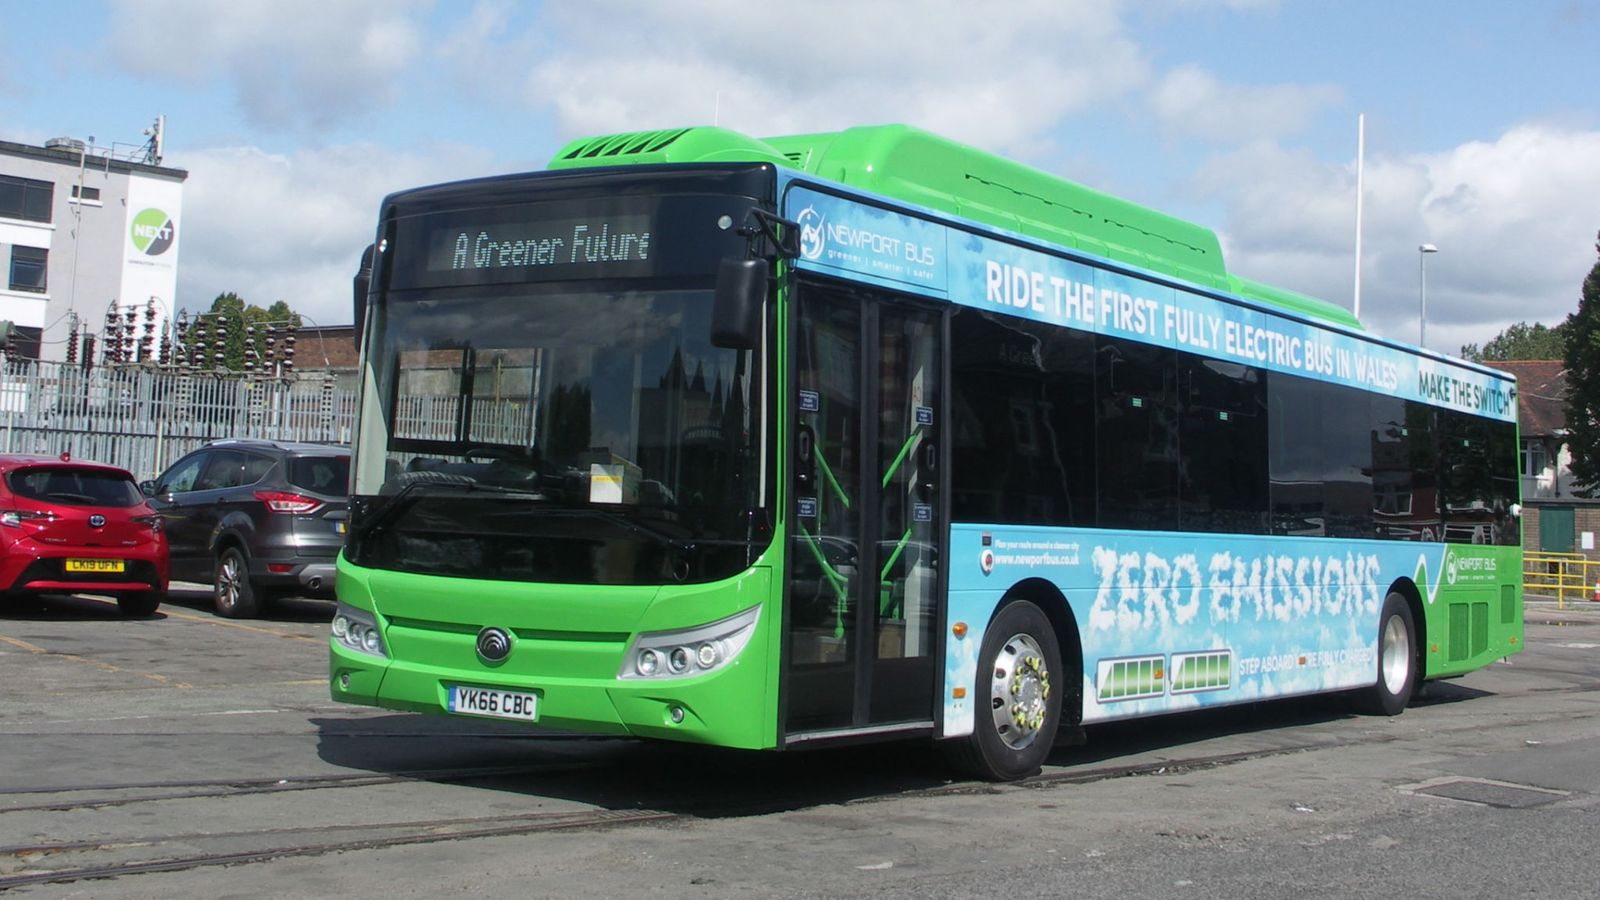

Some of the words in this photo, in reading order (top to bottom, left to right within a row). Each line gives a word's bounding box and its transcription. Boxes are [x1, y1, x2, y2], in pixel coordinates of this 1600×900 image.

[134, 223, 172, 240] NEXT
[453, 232, 469, 269] A
[473, 231, 564, 268] Greener
[570, 223, 650, 263] Future
[827, 222, 900, 257] NEWPORT
[905, 242, 935, 266] BUS
[827, 249, 861, 263] greener
[872, 259, 904, 273] smarter
[913, 269, 934, 280] safer
[986, 260, 1045, 313] RIDE
[1050, 276, 1095, 323] THE
[1101, 289, 1159, 337] FIRST
[1164, 304, 1221, 350] FULLY
[1225, 319, 1302, 368] ELECTRIC
[1305, 340, 1333, 376] BUS
[1336, 348, 1350, 379] IN
[1354, 353, 1398, 391] WALES
[1418, 371, 1450, 402] MAKE
[1451, 379, 1472, 408] THE
[1473, 384, 1511, 416] SWITCH
[72, 560, 96, 570] CK19
[98, 560, 119, 570] UFN
[994, 552, 1080, 568] www.newportbus.co.uk
[1456, 557, 1483, 570] NEWPORT
[1484, 558, 1497, 570] BUS
[1089, 545, 1202, 631] ZERO
[1208, 549, 1381, 625] EMISSIONS
[1239, 658, 1260, 676] STEP
[1261, 654, 1293, 673] ABOARD
[1318, 650, 1340, 667] FULLY
[460, 689, 499, 711] YK66
[502, 694, 534, 716] CBC
